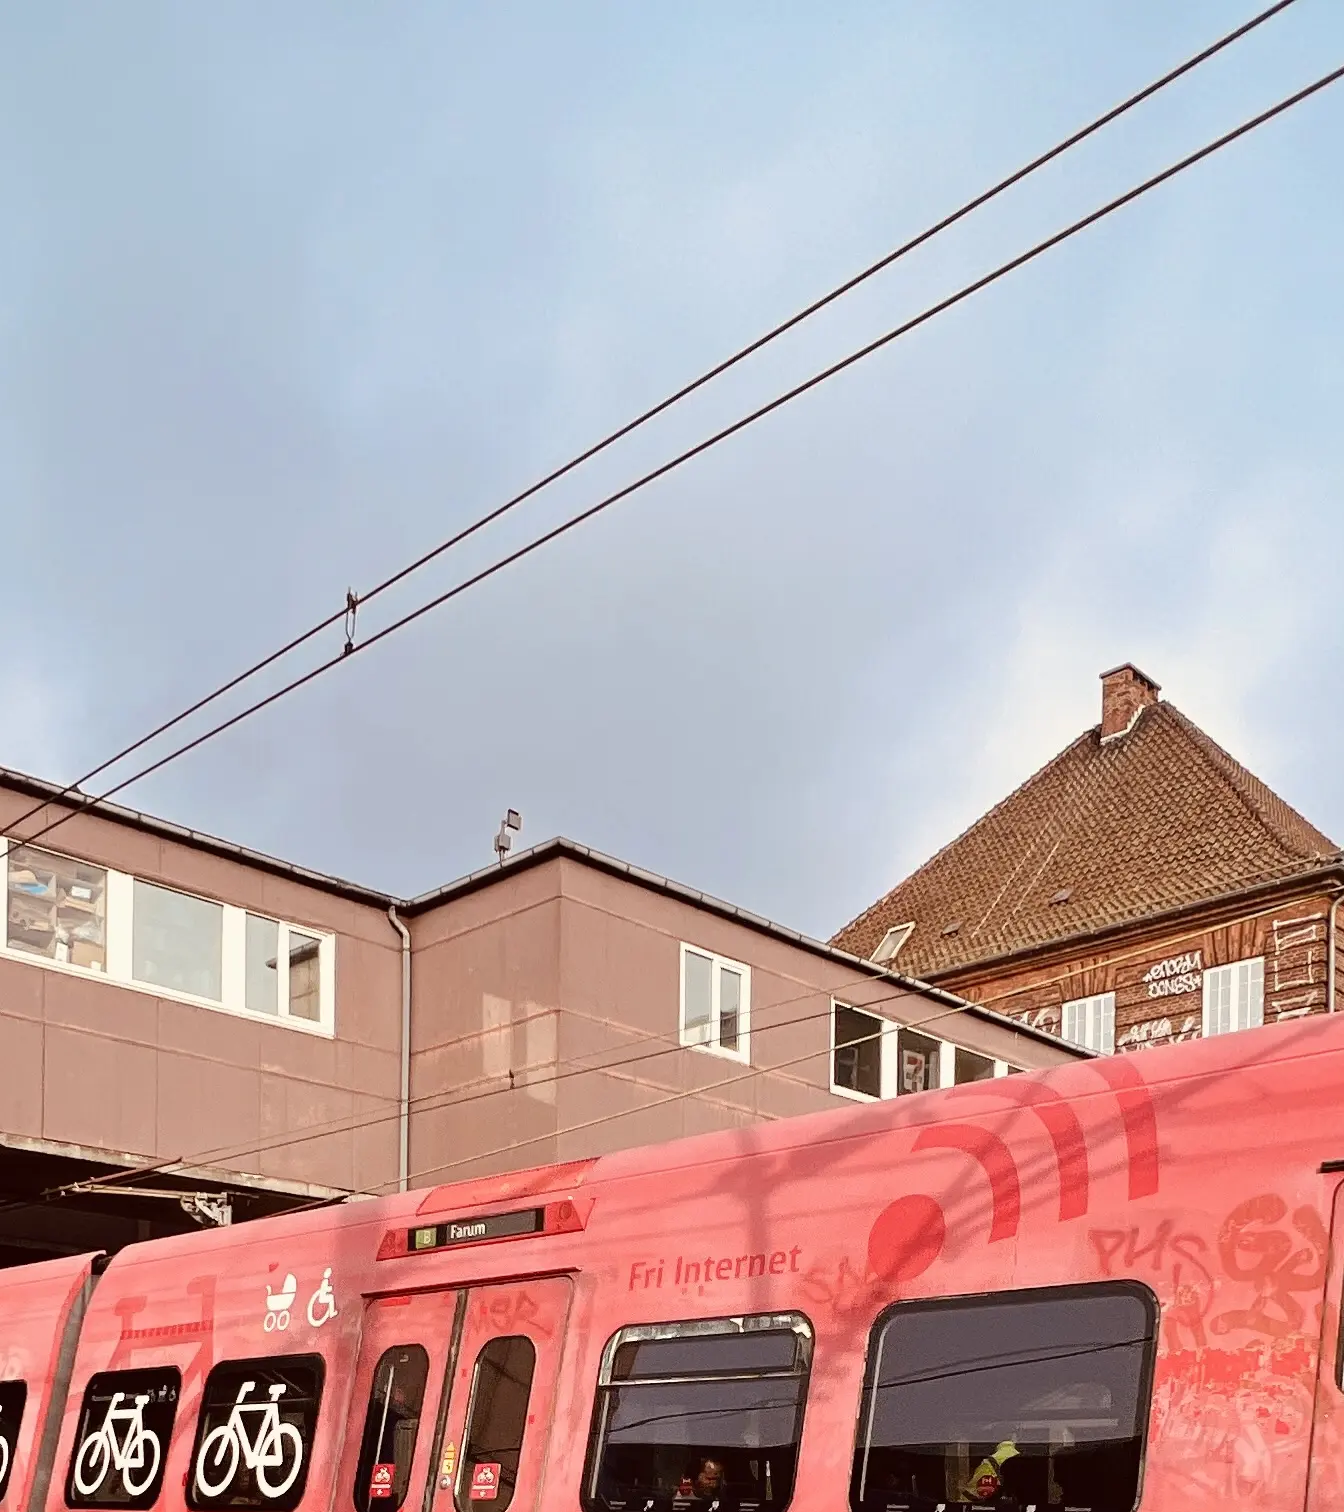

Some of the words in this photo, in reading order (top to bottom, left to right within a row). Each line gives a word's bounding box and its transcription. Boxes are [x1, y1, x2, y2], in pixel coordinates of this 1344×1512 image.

[450, 1223, 486, 1239] Farum
[629, 1258, 665, 1291] Fri
[675, 1245, 802, 1285] Internet
